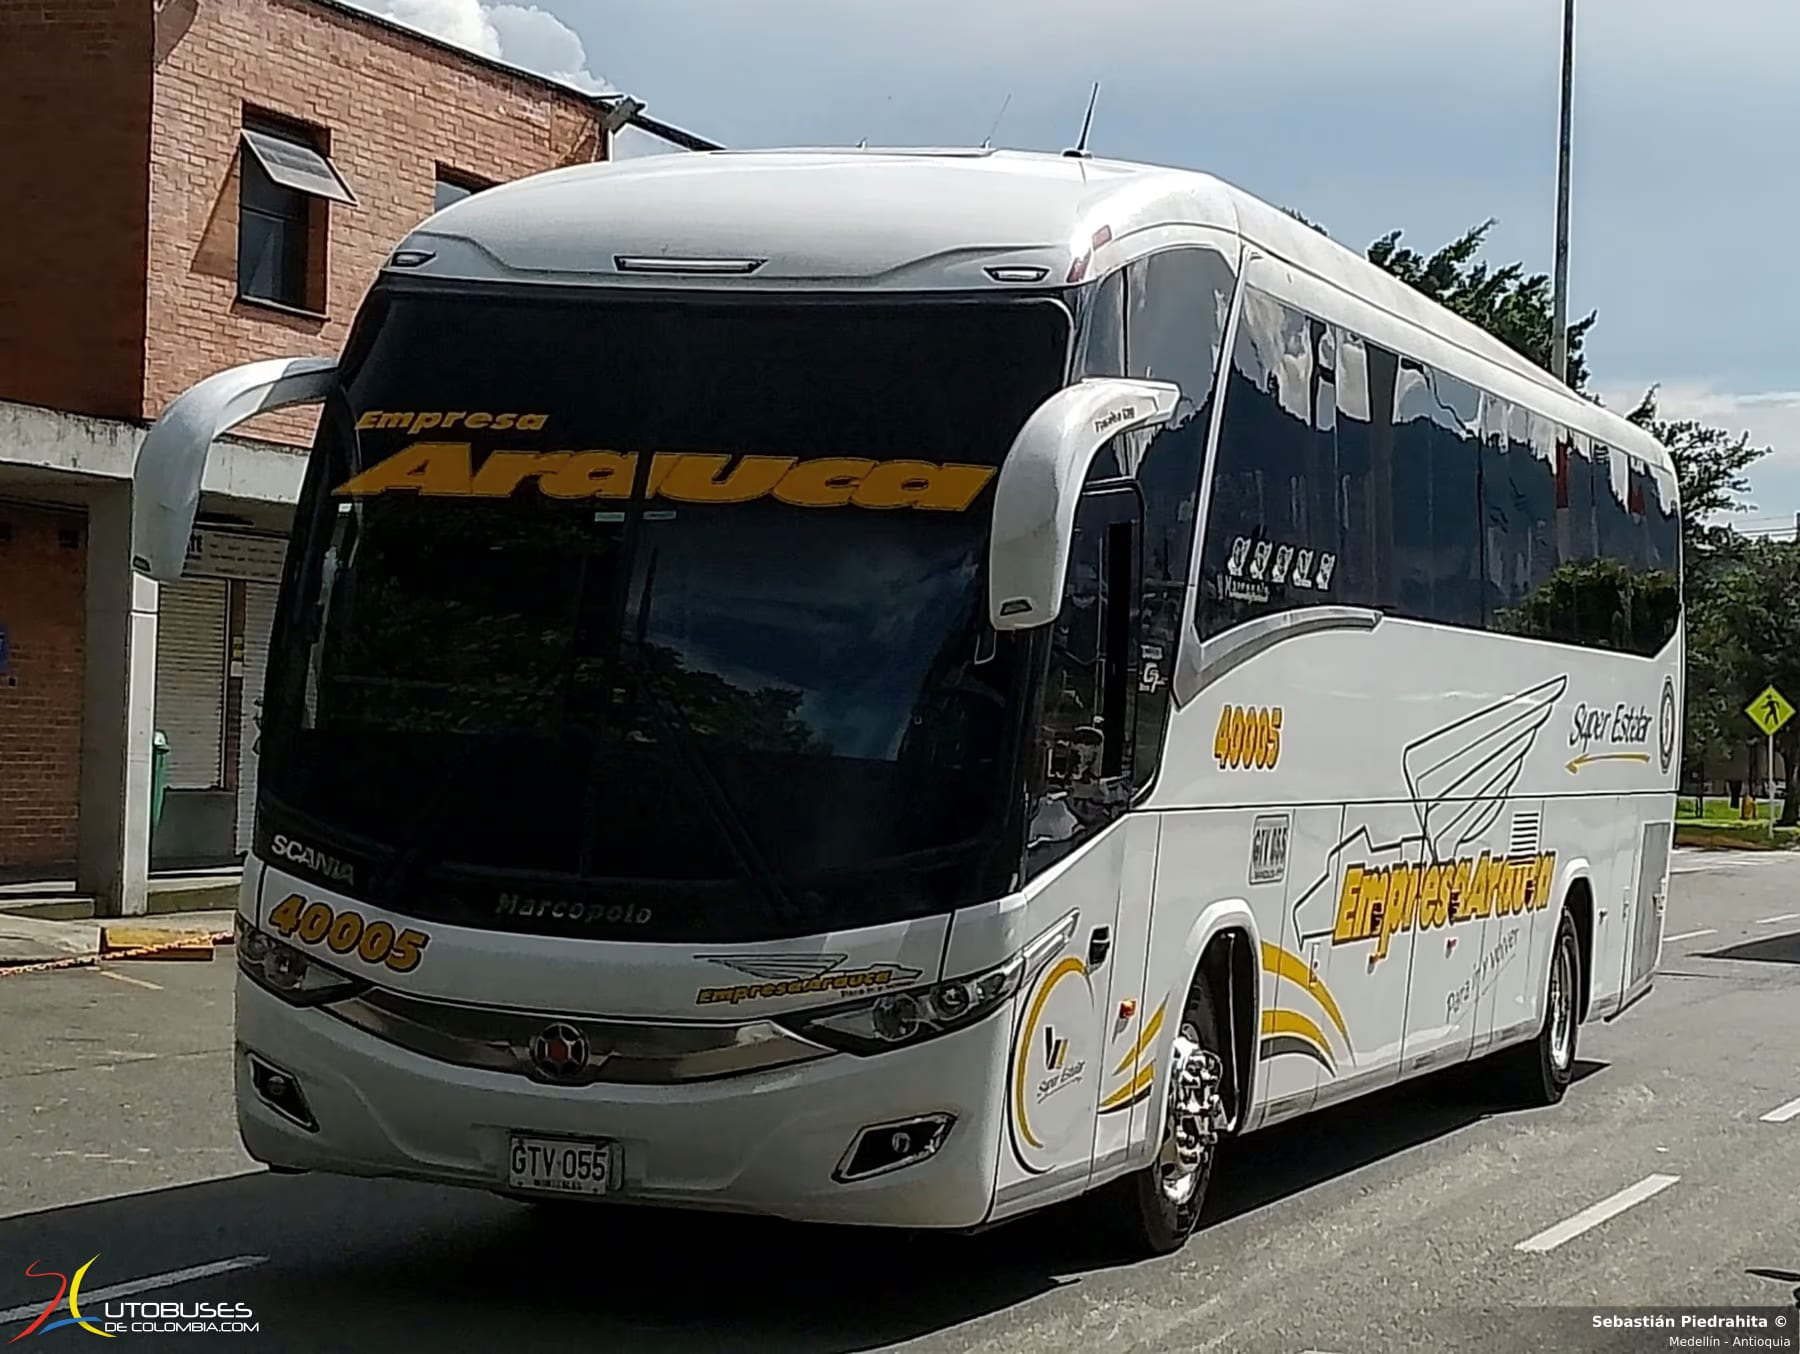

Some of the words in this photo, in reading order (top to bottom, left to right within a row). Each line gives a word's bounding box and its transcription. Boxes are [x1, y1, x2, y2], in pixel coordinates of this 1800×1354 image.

[354, 410, 549, 434] Empresa
[331, 442, 998, 512] Arauca
[1214, 704, 1283, 771] 40005
[1569, 703, 1612, 753] Super
[272, 834, 354, 886] SCANIA
[268, 892, 431, 974] 40005
[496, 892, 653, 925] Marcopolo
[511, 1144, 556, 1178] GTV
[562, 1149, 608, 1181] 055
